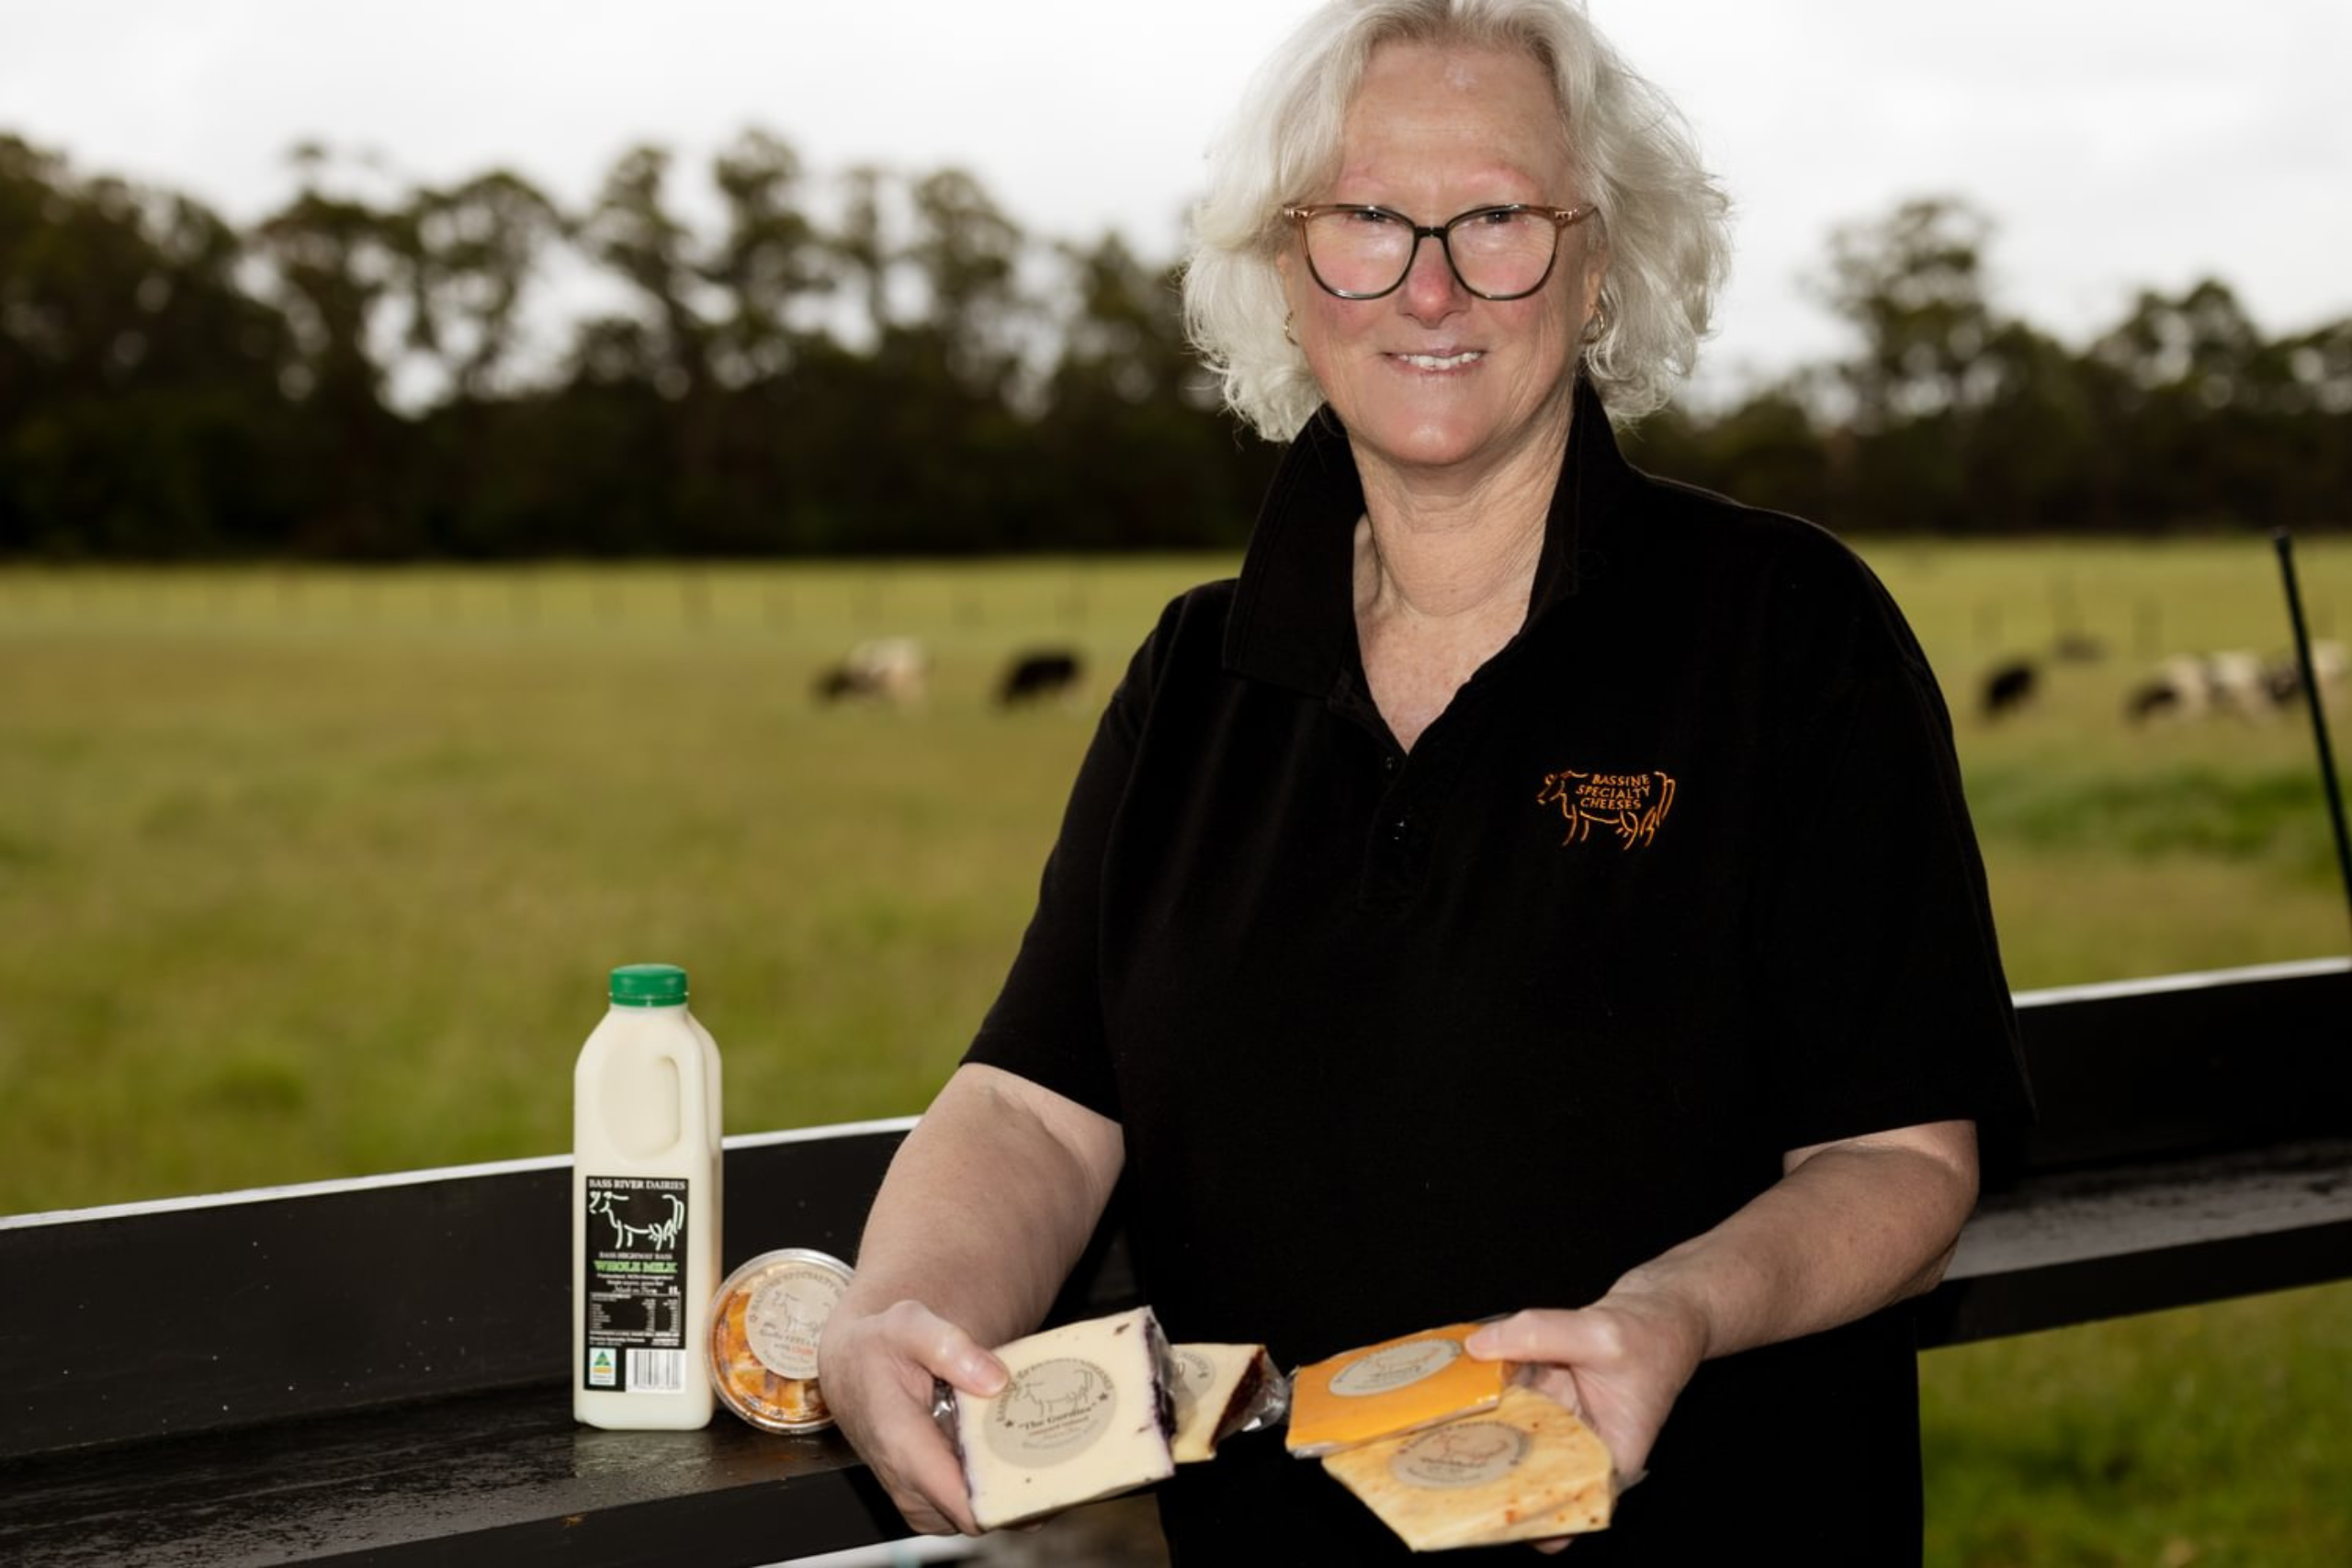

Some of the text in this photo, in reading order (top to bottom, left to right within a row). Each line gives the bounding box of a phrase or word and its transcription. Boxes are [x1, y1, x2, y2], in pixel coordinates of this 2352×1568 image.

[1591, 773, 1651, 786] BASSINE
[1575, 784, 1652, 799] SPECIALTY
[1579, 797, 1643, 810] CHEESES
[589, 1179, 686, 1190] BASS RIVER DAIRIES
[594, 1259, 678, 1273] WHOLE MILK
